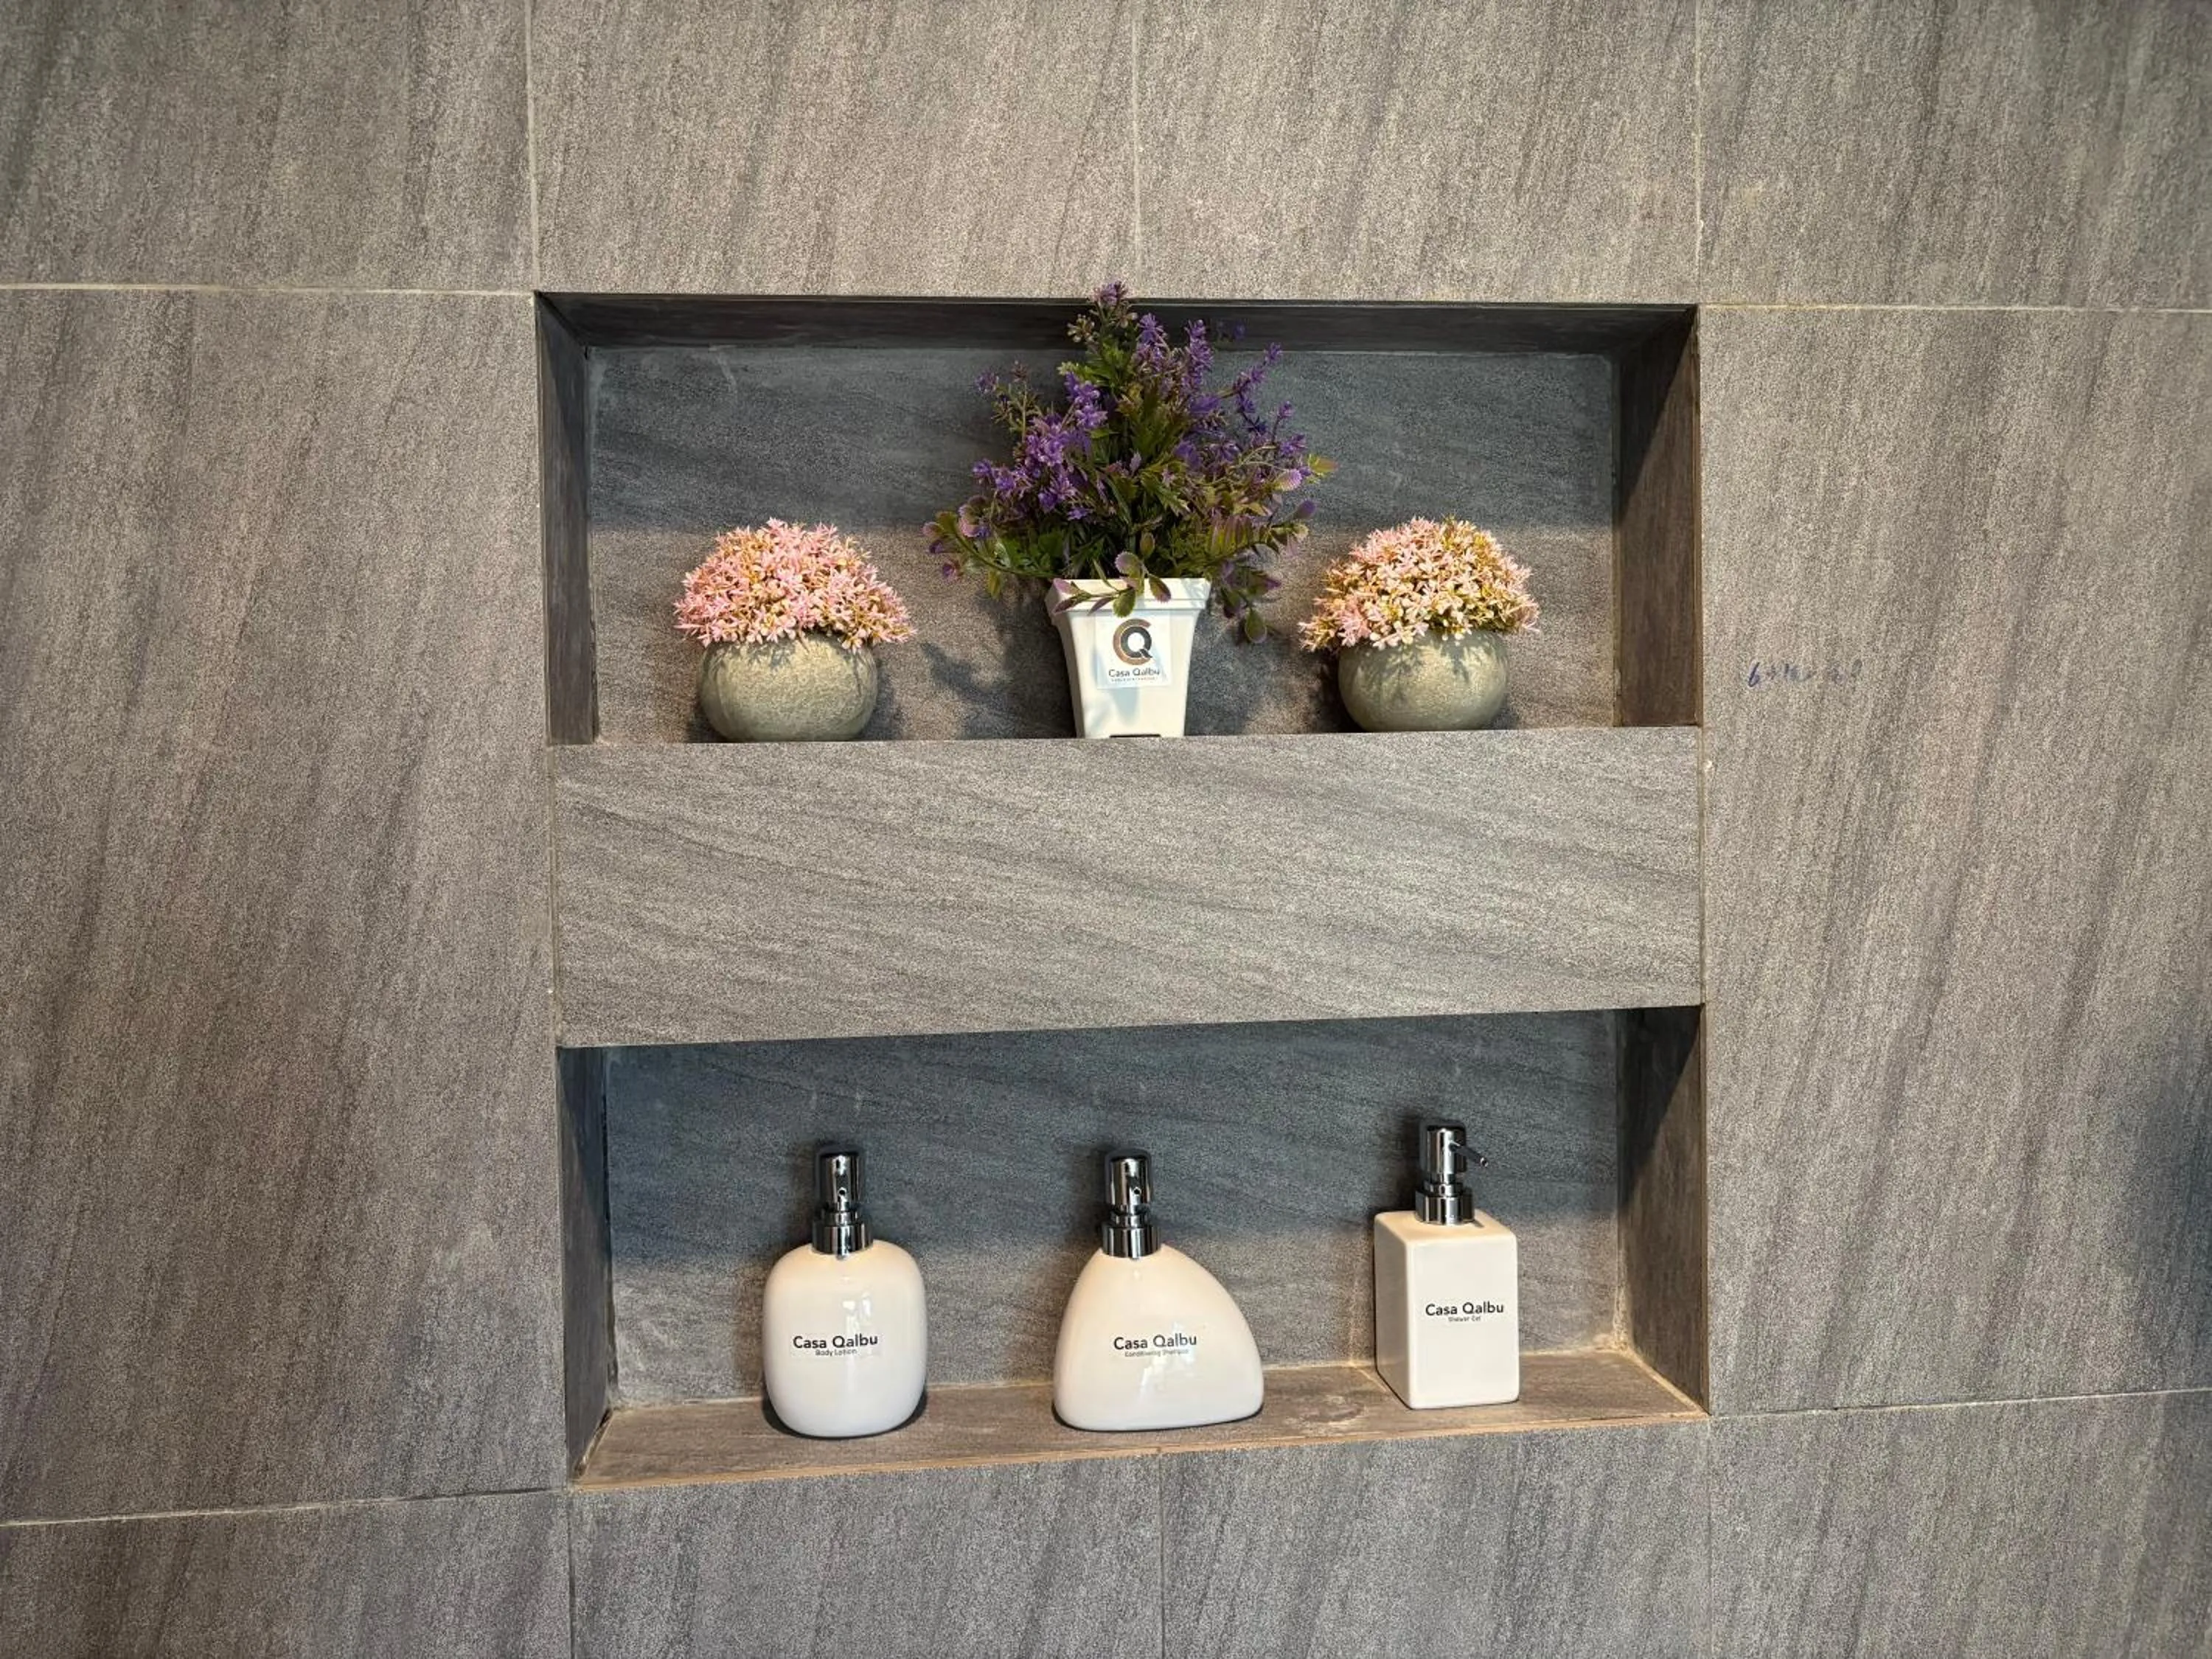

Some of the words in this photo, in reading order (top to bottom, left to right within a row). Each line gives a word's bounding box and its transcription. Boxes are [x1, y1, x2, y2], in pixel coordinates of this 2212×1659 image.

[1108, 669, 1130, 677] Casa
[1425, 1303, 1458, 1316] Casa
[1462, 1301, 1504, 1315] Qalbu
[793, 1335, 827, 1349] Casa
[832, 1333, 878, 1349] Qalbu
[1113, 1336, 1148, 1350] Casa
[1152, 1332, 1197, 1348] Qalbu
[815, 1349, 833, 1357] Body
